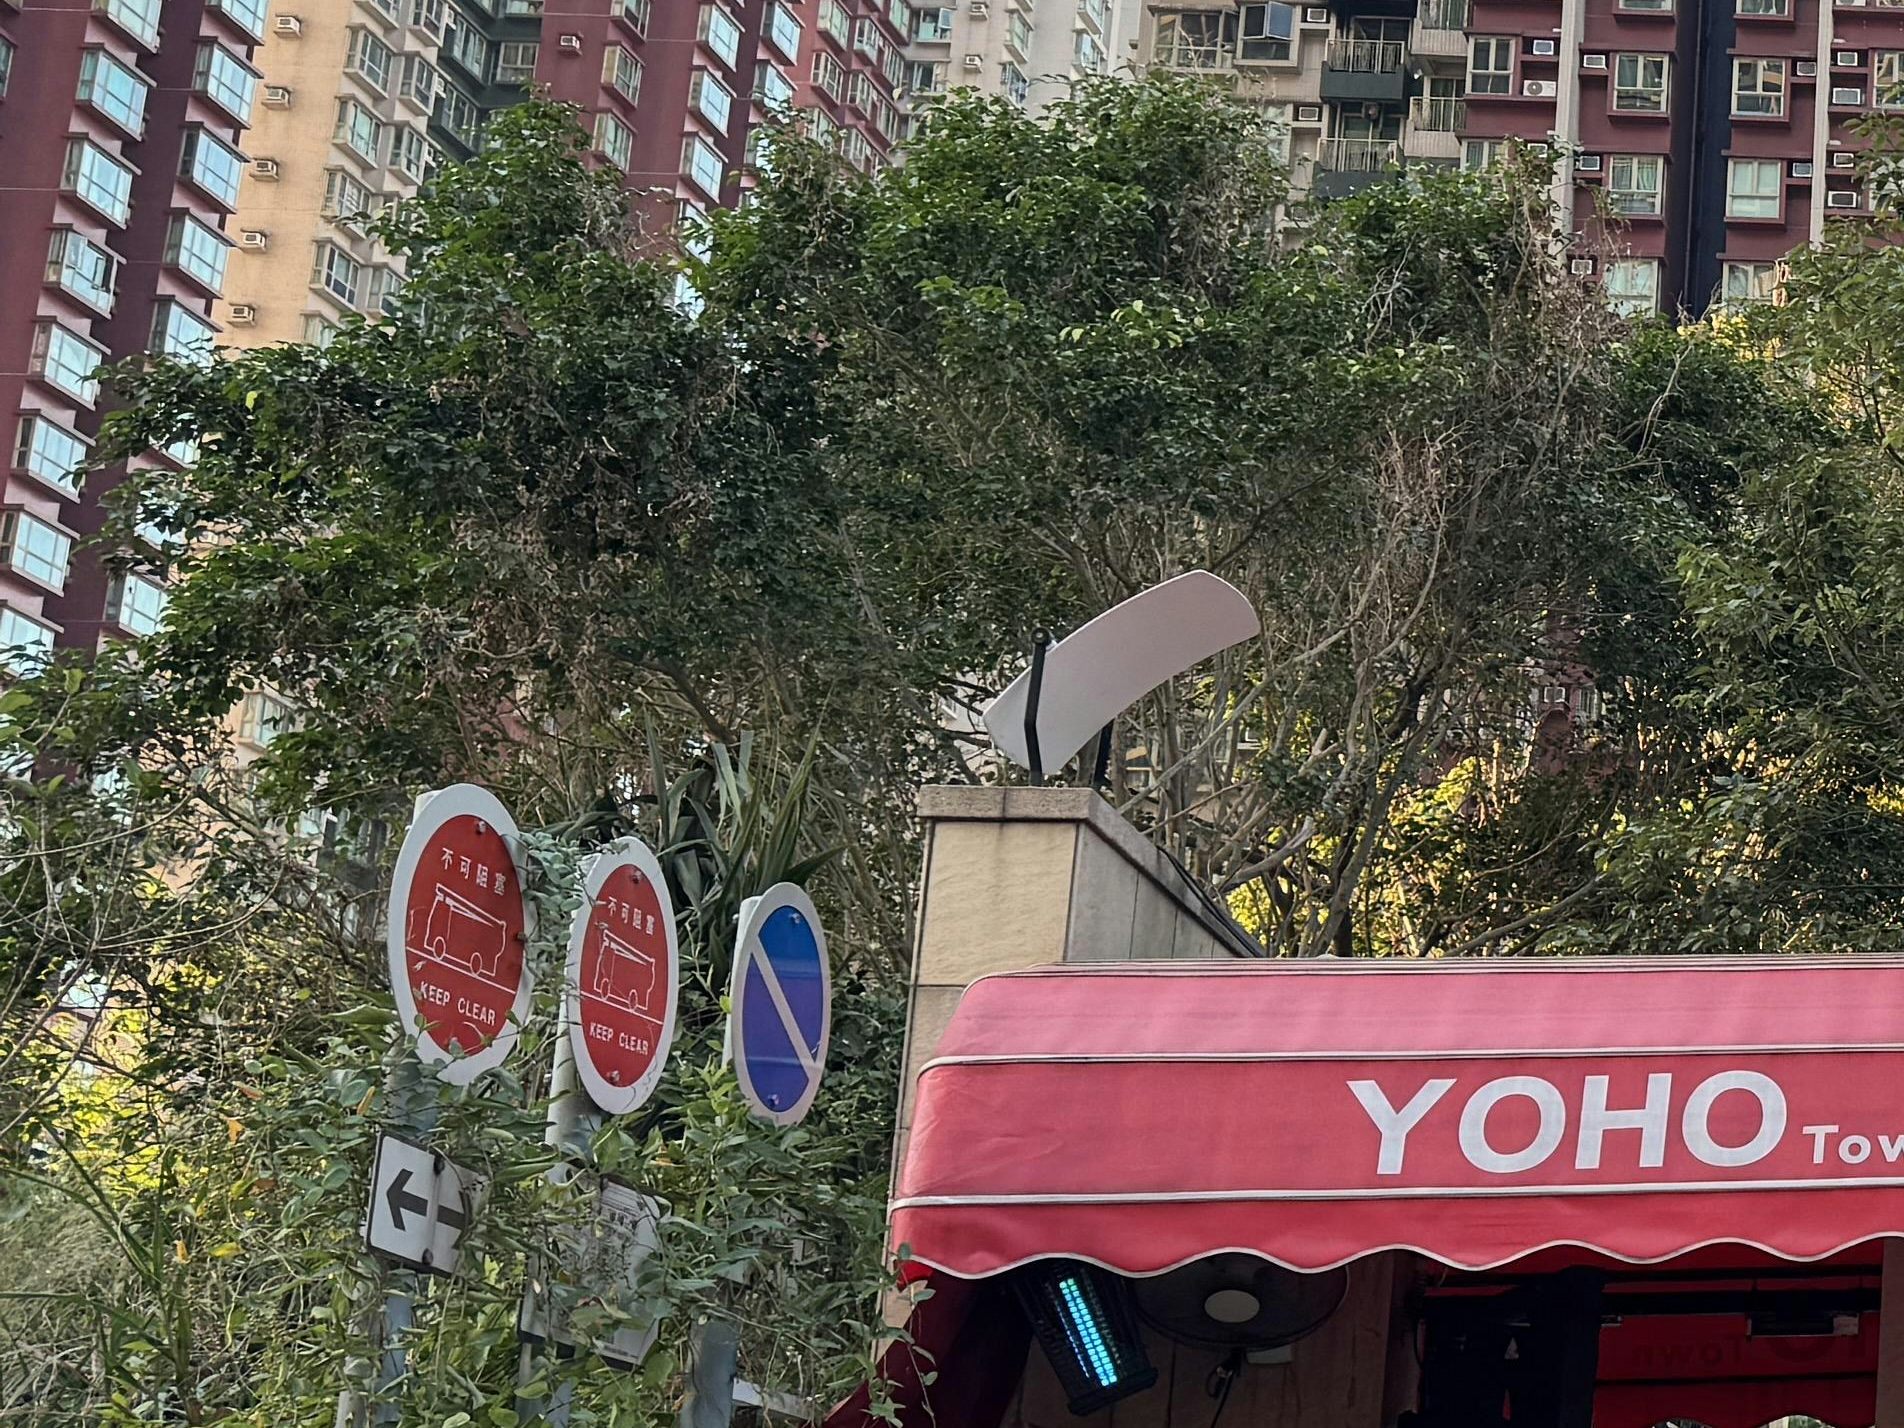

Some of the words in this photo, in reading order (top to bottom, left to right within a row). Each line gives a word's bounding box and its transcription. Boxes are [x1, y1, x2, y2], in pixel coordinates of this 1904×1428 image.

[441, 847, 507, 896] 不可阻塞
[608, 896, 654, 935] 不可阻塞
[420, 981, 450, 1006] KEEP
[457, 998, 496, 1026] CLEAR
[589, 1022, 614, 1041] KEEP
[618, 1032, 648, 1055] CLEAR
[1346, 1069, 1788, 1176] YOHO
